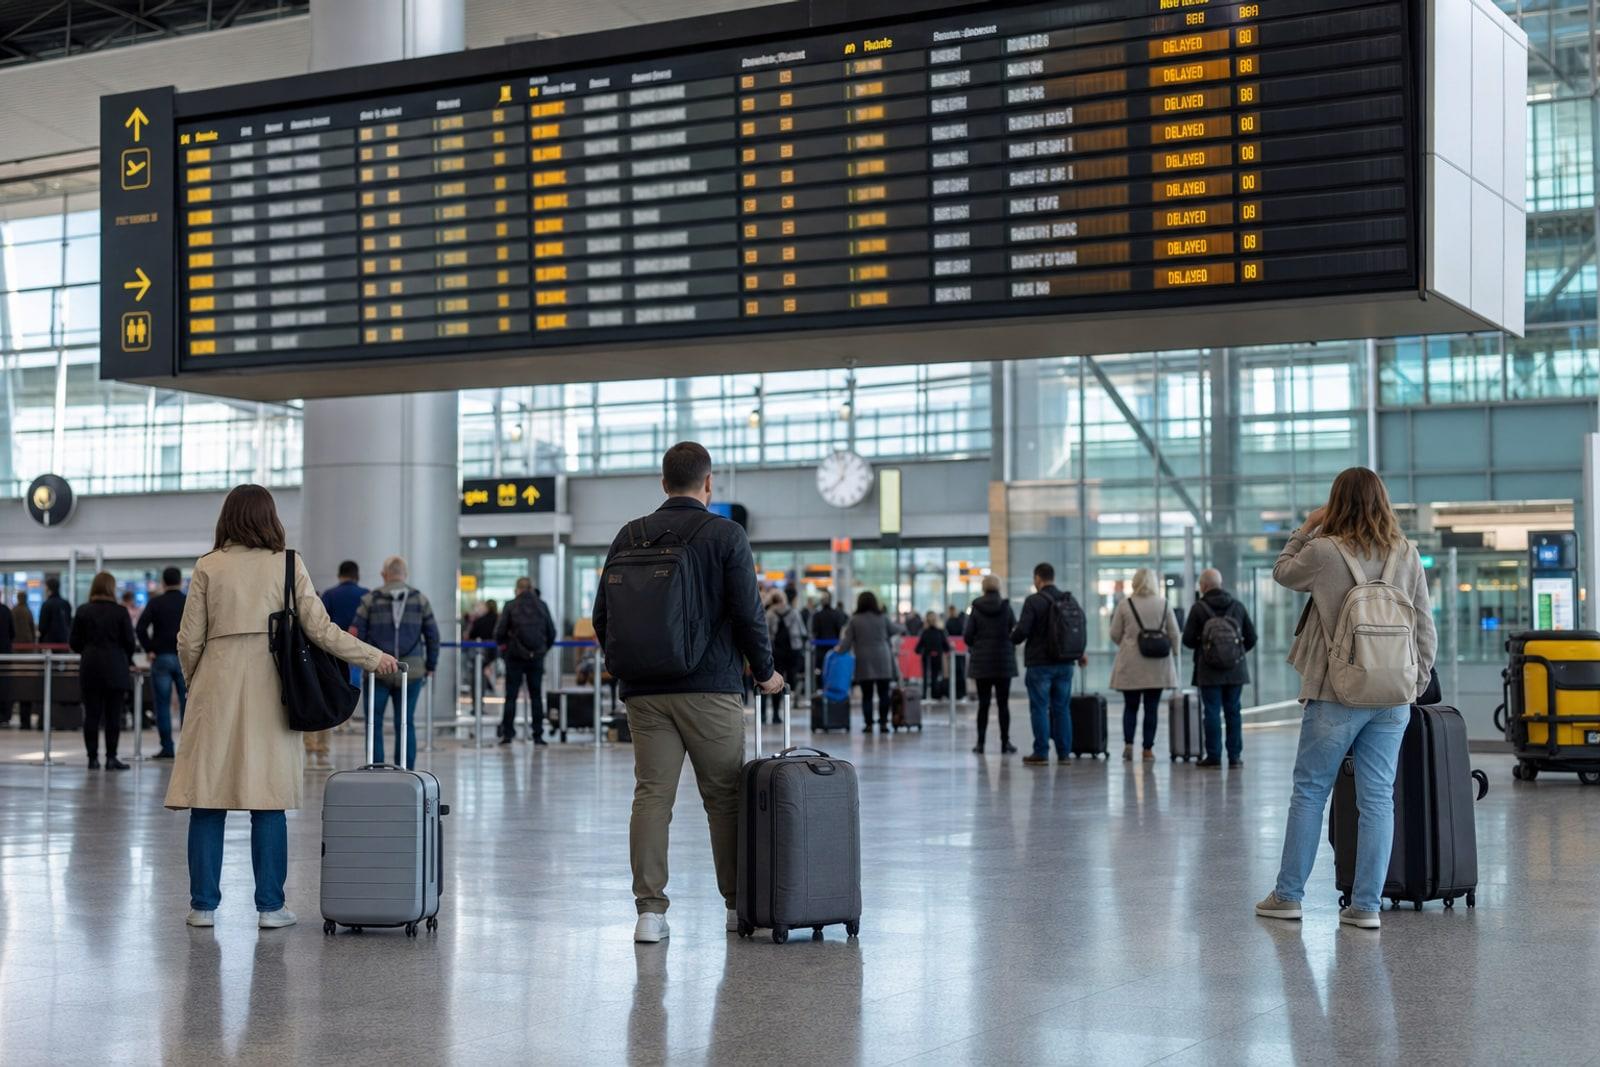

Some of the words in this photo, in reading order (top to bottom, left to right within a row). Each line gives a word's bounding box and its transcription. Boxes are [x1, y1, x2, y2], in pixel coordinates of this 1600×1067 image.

[1163, 37, 1202, 53] DELAYED
[1164, 65, 1203, 82] DELAYED
[1164, 94, 1203, 111] DELAYED
[1165, 123, 1204, 139] DELAYED
[1165, 152, 1205, 168] DELAYED
[1167, 210, 1206, 226] DELAYED
